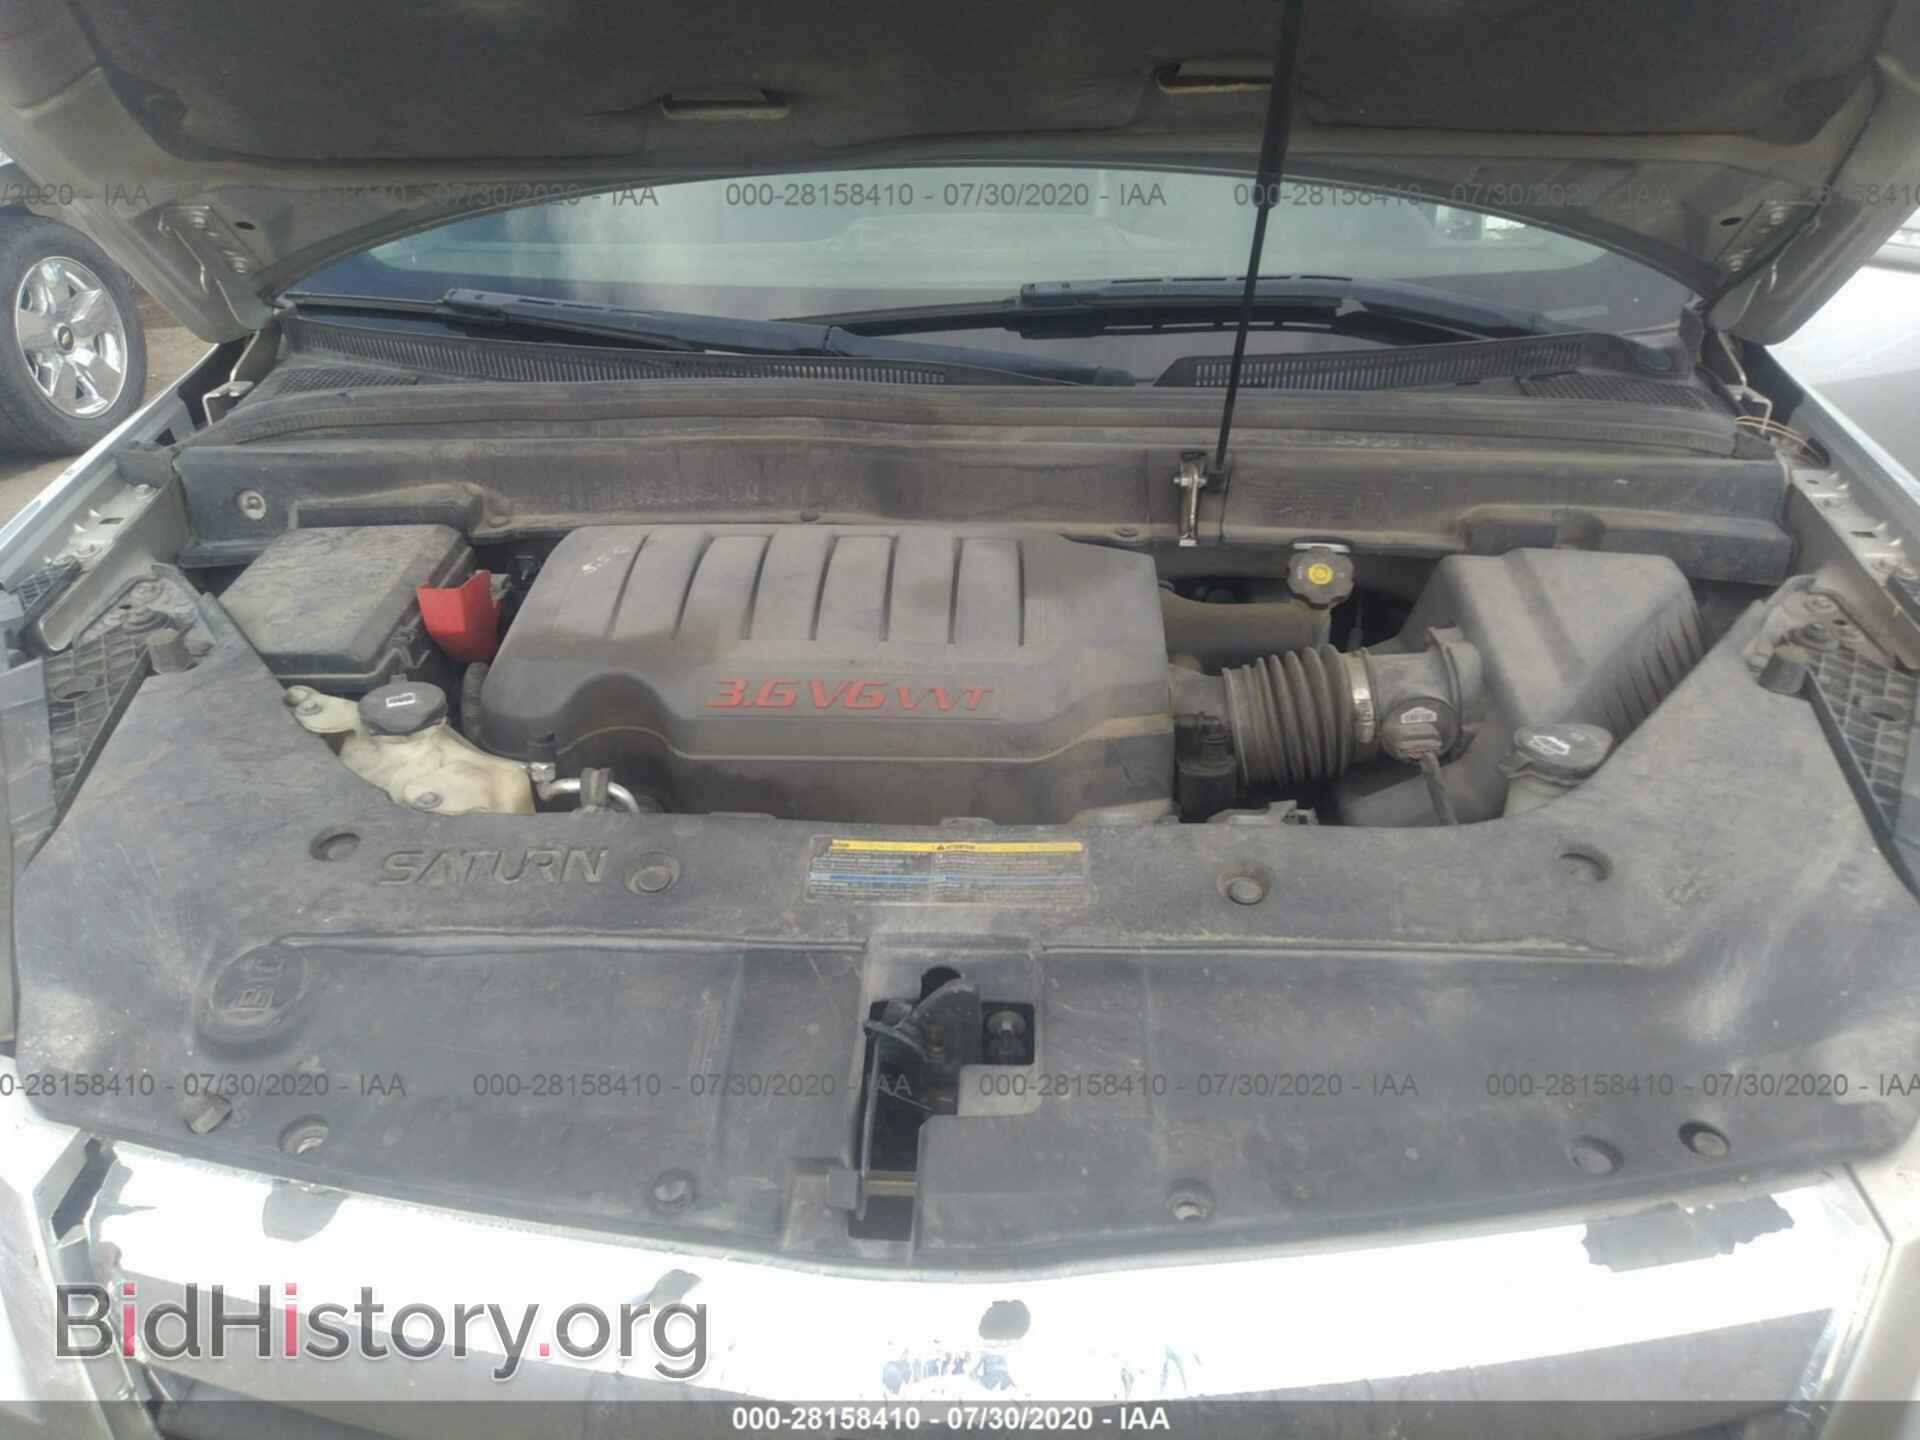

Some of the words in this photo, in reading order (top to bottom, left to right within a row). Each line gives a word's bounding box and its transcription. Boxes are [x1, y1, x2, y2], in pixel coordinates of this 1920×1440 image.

[703, 676, 800, 709] 3.6
[806, 677, 888, 711] V6
[895, 682, 995, 712] VVT
[377, 848, 609, 886] SATURN
